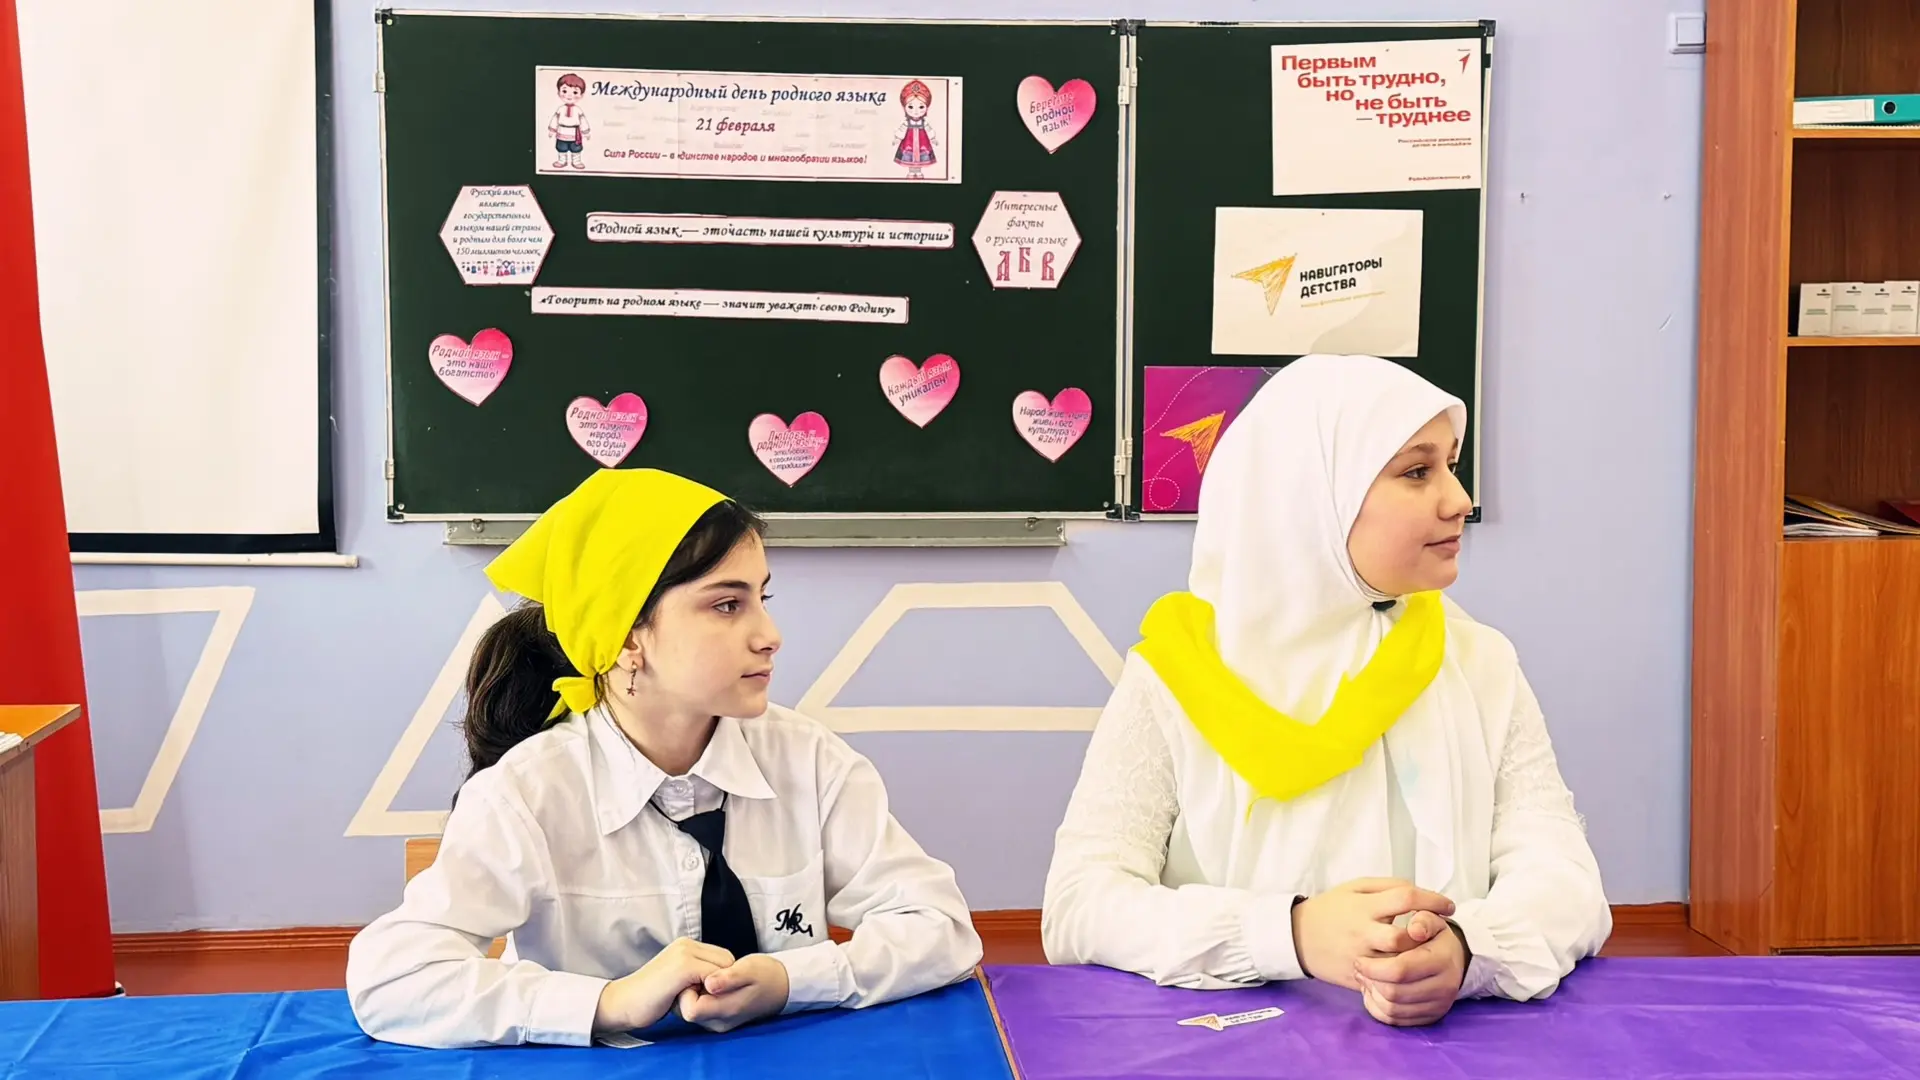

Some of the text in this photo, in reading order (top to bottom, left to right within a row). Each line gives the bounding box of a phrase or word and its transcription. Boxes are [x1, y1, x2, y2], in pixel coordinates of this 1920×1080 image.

[1281, 55, 1377, 73] Первым
[1297, 72, 1446, 89] быть трудно,
[592, 80, 888, 106] Международный день родного языка
[1326, 89, 1355, 101] но
[1355, 93, 1448, 110] не быть
[1035, 105, 1075, 127] родной
[1376, 109, 1471, 128] труднее
[695, 118, 713, 131] 21
[715, 117, 776, 136] февраля
[603, 148, 626, 158] Сила
[628, 149, 661, 159] России
[720, 152, 758, 163] народов
[470, 188, 502, 198] Русский
[994, 200, 1058, 214] Интересные
[486, 224, 510, 232] нашей
[1006, 216, 1044, 230] факты
[589, 221, 642, 235] «Родной
[644, 226, 683, 238] язык
[769, 227, 809, 238] нашей
[877, 231, 885, 240] и
[889, 231, 950, 244] истории»
[993, 236, 1035, 246] русском
[1037, 237, 1068, 247] языке
[1300, 257, 1383, 282] НАВИГАТОРЫ
[1300, 277, 1357, 299] ДЕТСТВА
[540, 294, 604, 309] «Говорить
[606, 297, 620, 306] на
[622, 295, 666, 309] родном
[722, 301, 765, 309] значит
[767, 302, 818, 313] уважать
[819, 304, 847, 312] свою
[849, 302, 896, 317] Родину»
[446, 360, 467, 368] это
